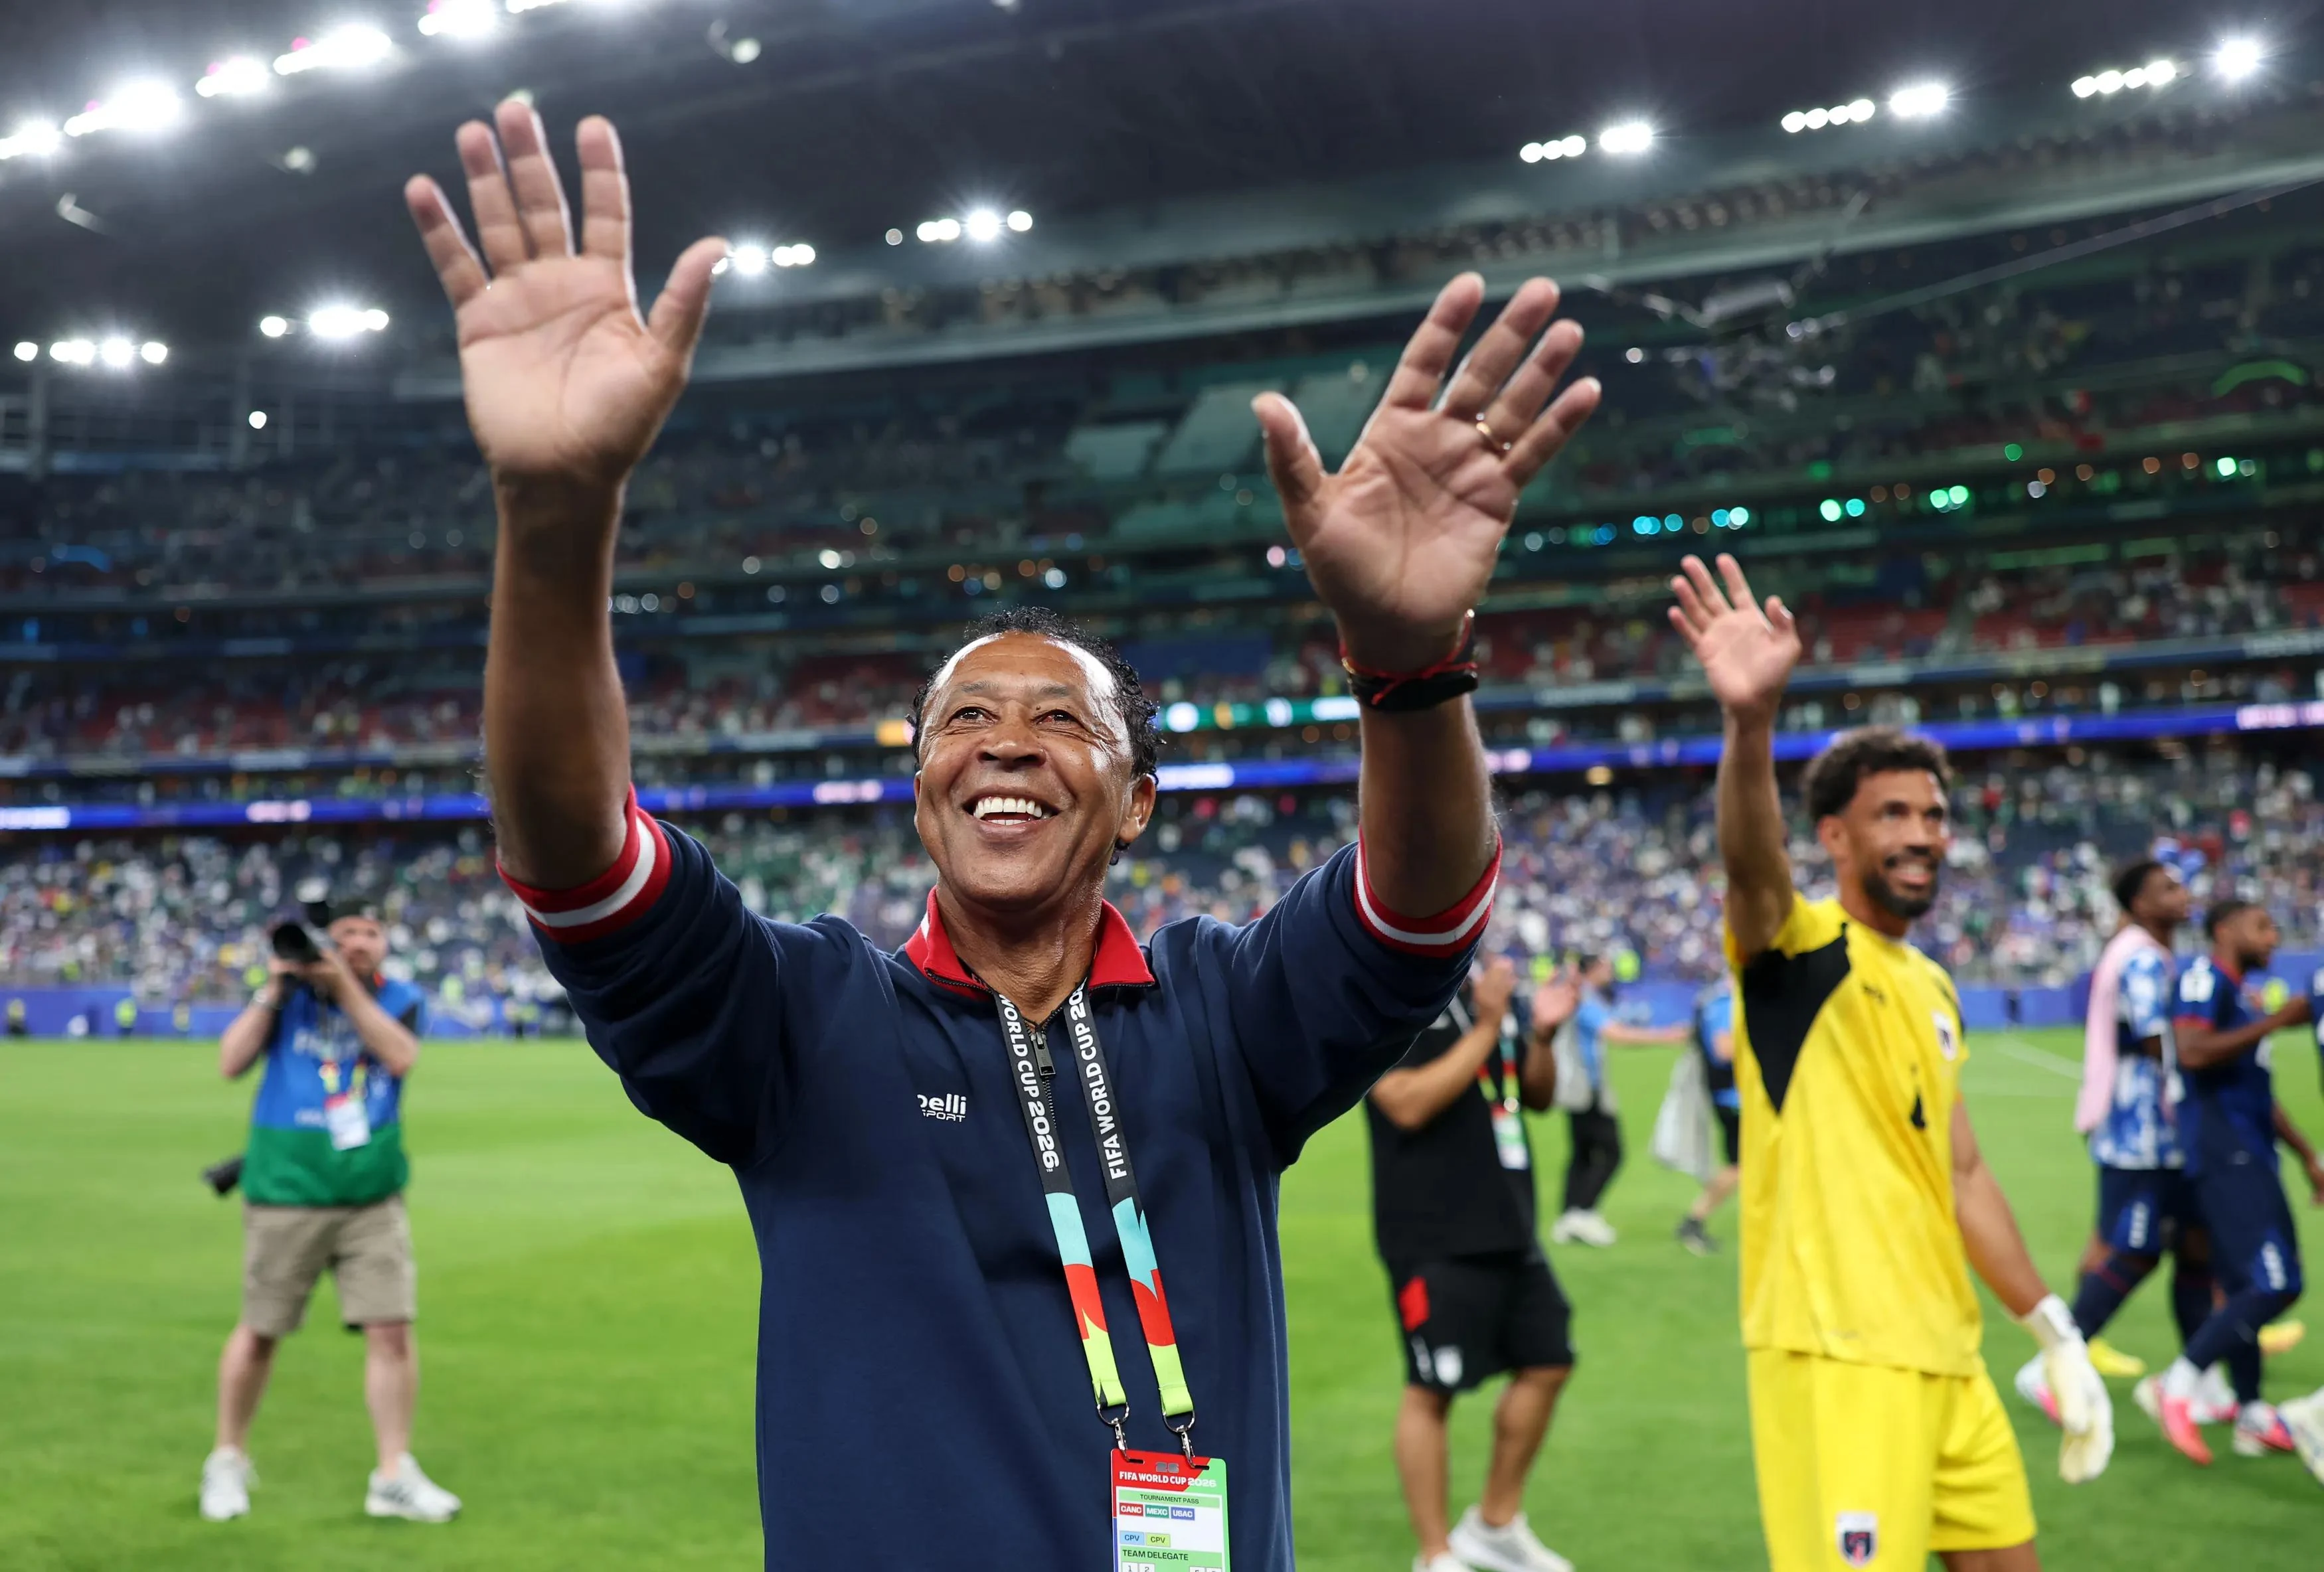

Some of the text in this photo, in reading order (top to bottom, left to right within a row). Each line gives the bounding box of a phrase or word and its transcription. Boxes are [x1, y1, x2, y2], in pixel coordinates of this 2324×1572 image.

[1017, 1060, 1040, 1098] CUP
[1068, 977, 1127, 1180] FIFA WORLD CUP 20
[1028, 1101, 1059, 1169] 2026
[1119, 1471, 1216, 1487] FIFA WORLD CUP 2026
[1140, 1494, 1182, 1503] TOURNAMENT
[1146, 1507, 1168, 1516] MEXC
[1122, 1549, 1189, 1561] TEAM DELEGATE
